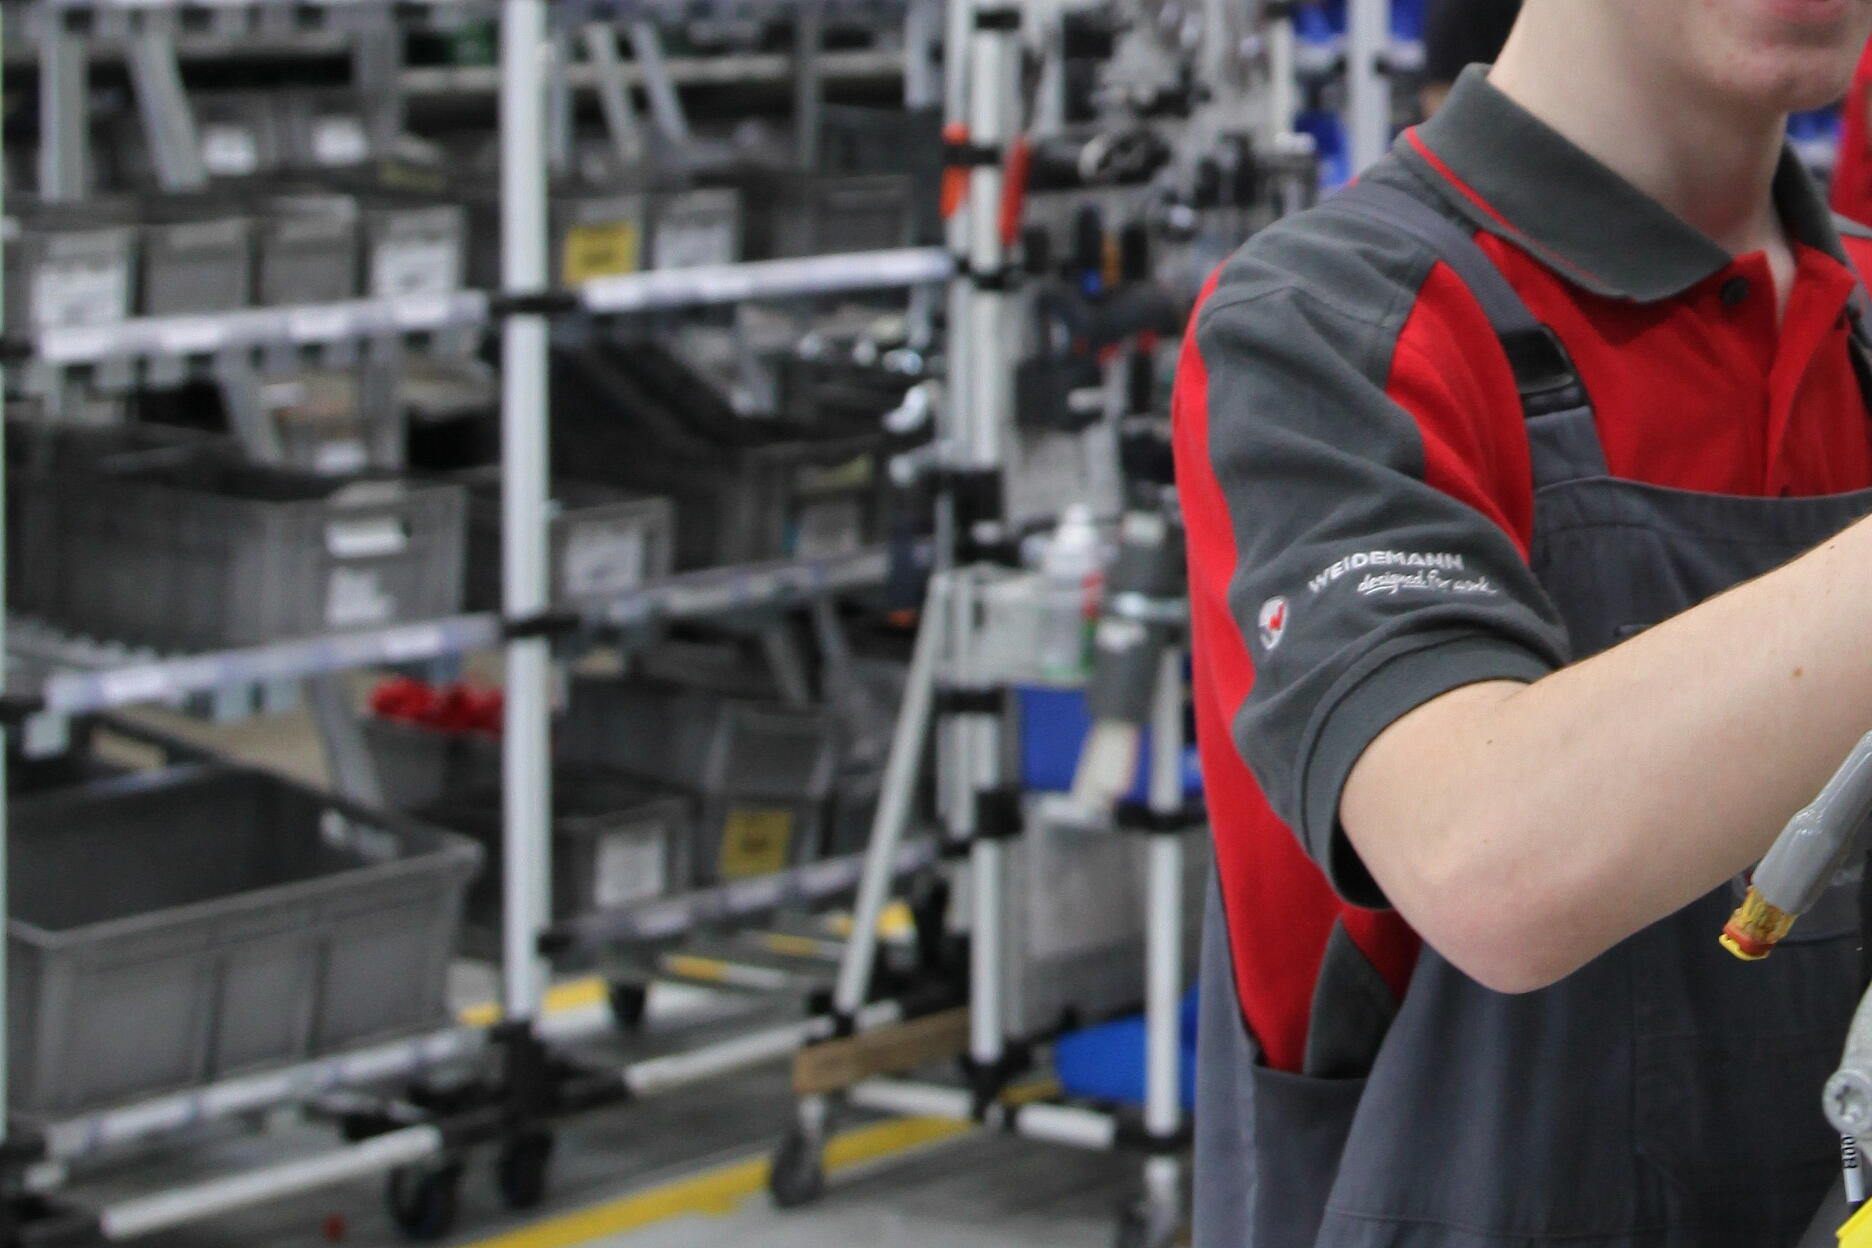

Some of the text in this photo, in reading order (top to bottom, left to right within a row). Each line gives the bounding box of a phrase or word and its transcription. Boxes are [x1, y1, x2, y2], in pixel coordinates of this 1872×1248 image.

[1307, 550, 1465, 593] WEIDEMANN
[1357, 569, 1427, 595] designed
[1427, 569, 1452, 590] for
